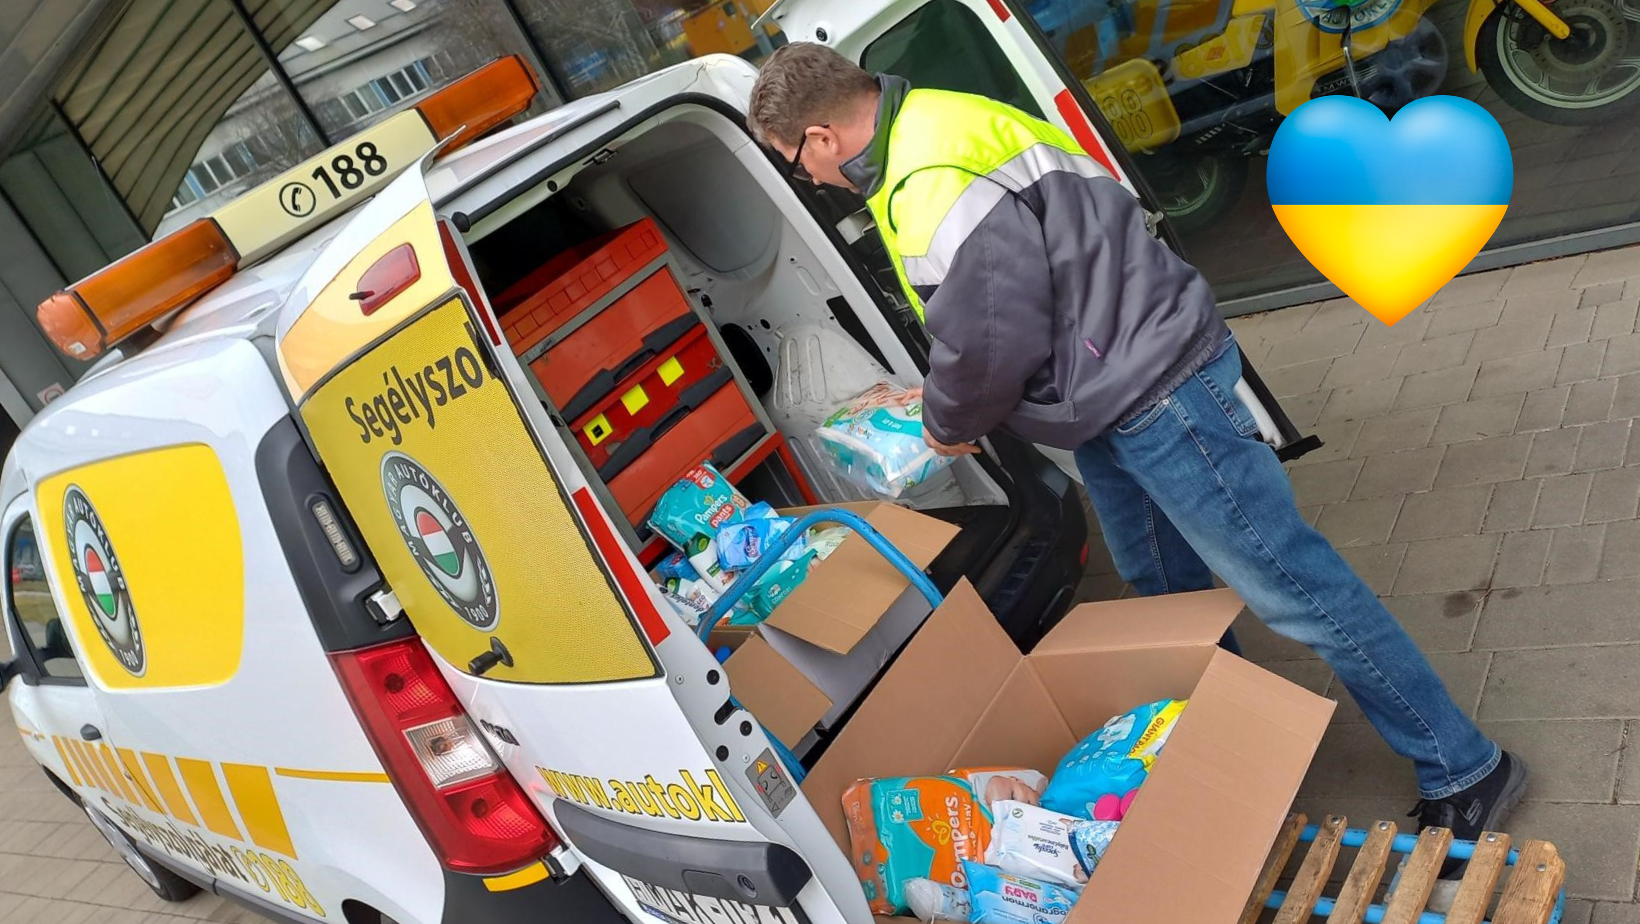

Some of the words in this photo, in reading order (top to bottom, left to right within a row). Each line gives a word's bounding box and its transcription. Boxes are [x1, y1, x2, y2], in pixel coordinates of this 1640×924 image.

[311, 142, 388, 199] 188
[387, 470, 420, 556] MAGYAR
[394, 463, 473, 544] AUTÓKLUB
[694, 494, 728, 525] Pampers
[711, 504, 732, 528] pants
[464, 604, 489, 622] 1900
[1142, 717, 1165, 743] GIANT
[534, 765, 747, 822] www.autokl
[945, 795, 970, 889] Pmpers
[1004, 885, 1038, 903] BABY
